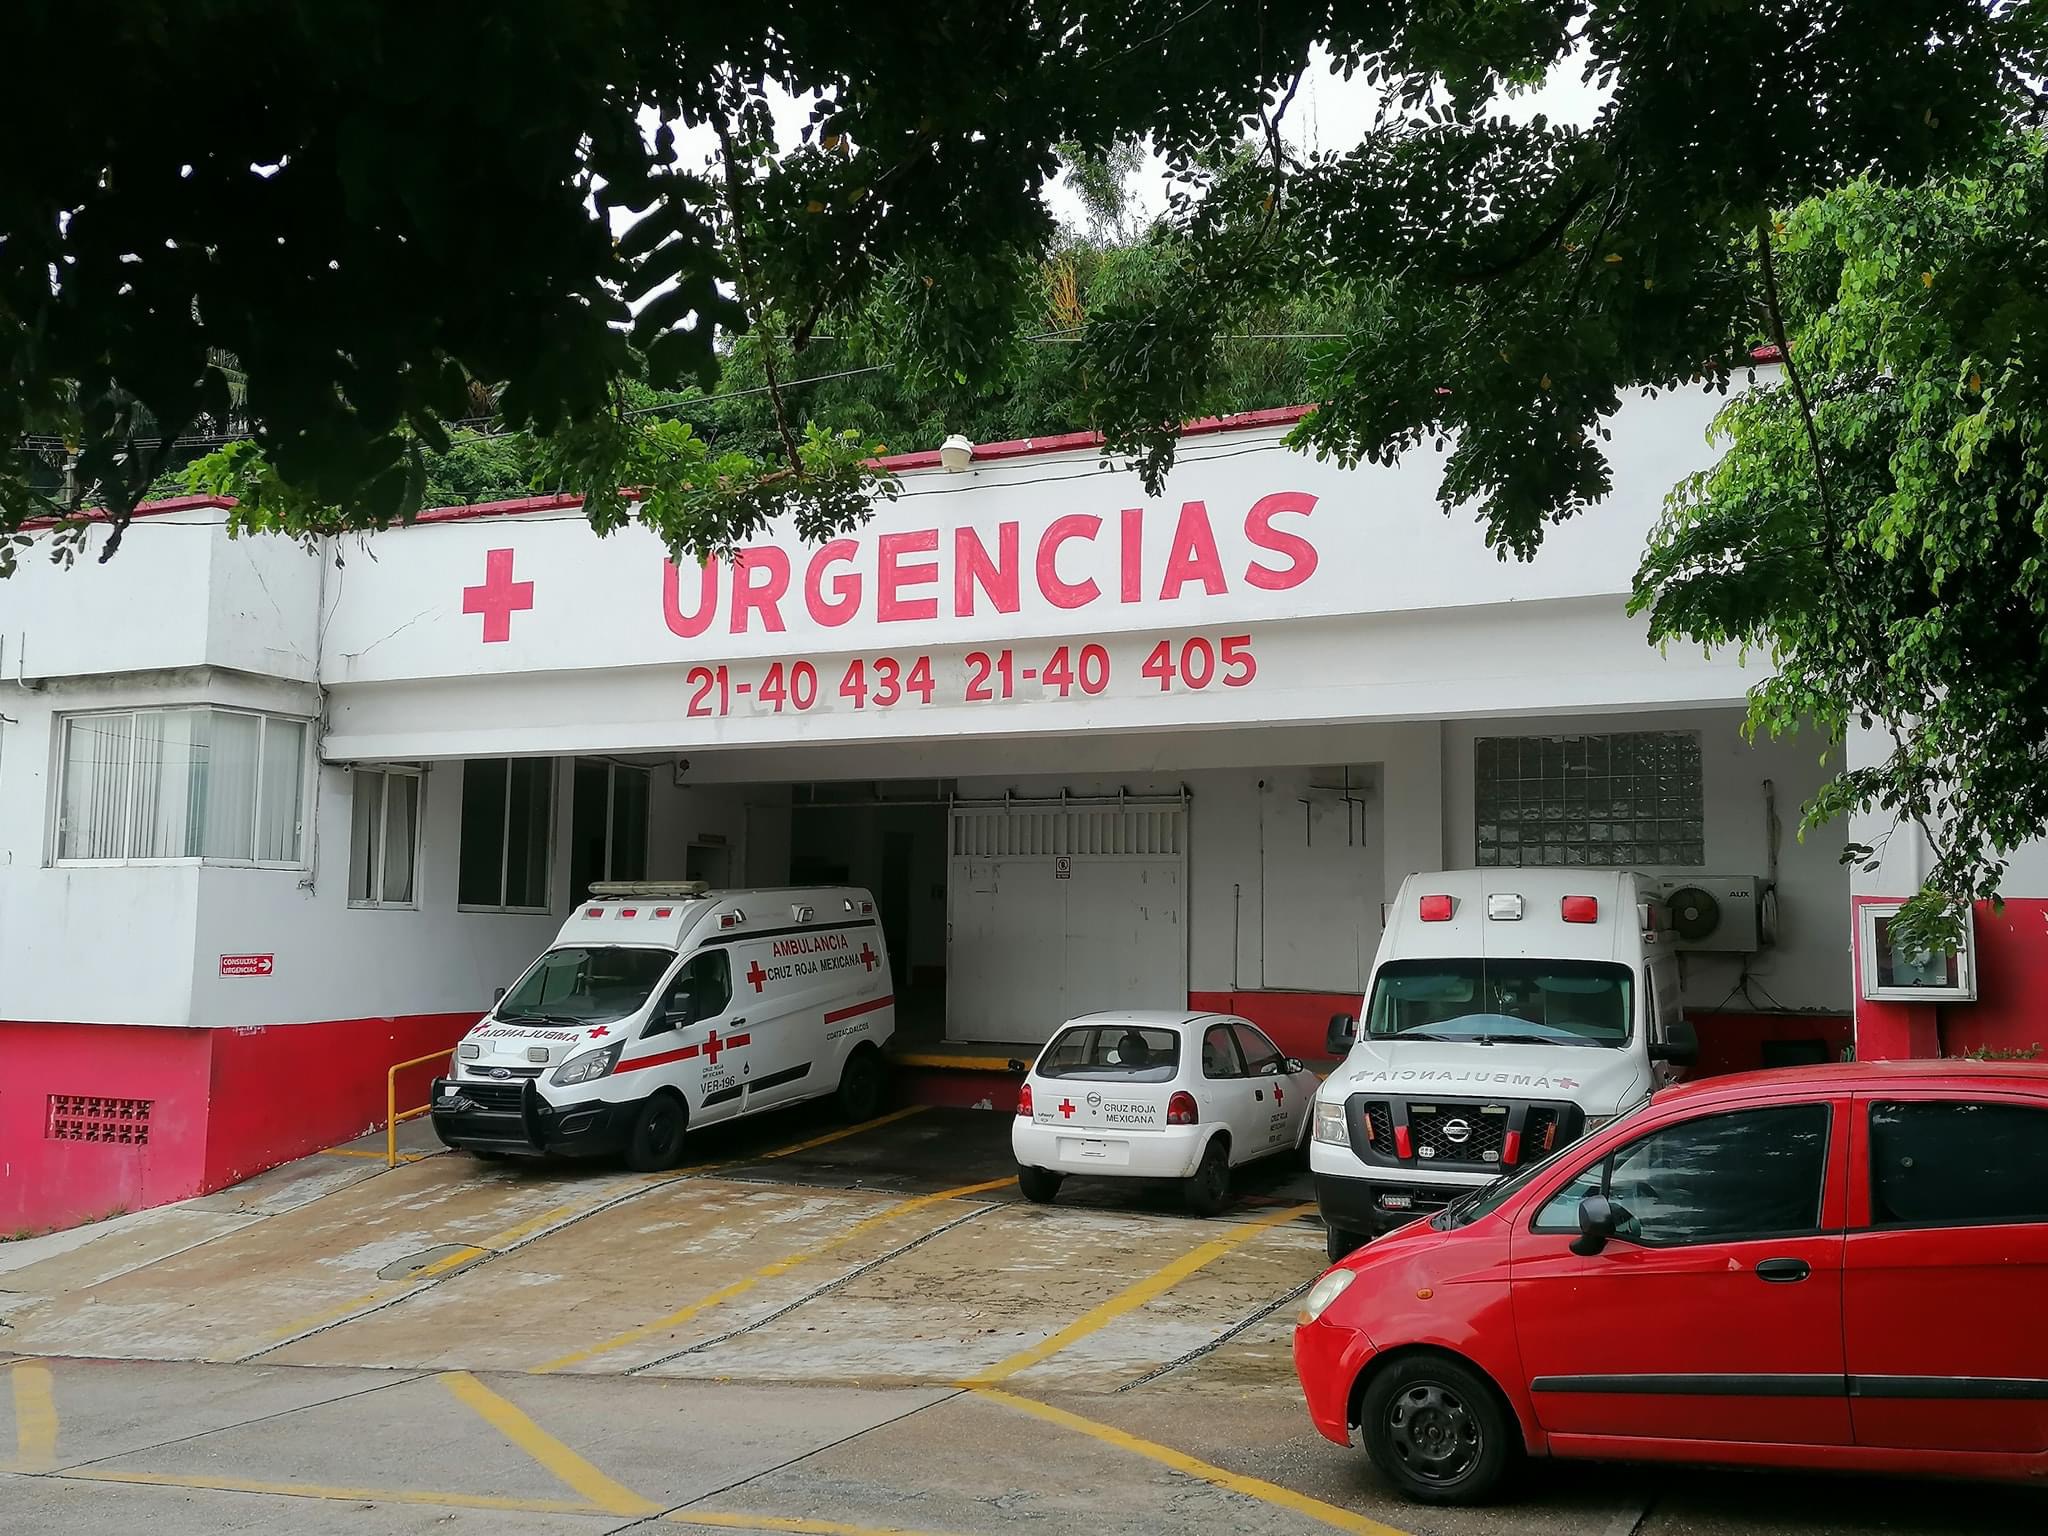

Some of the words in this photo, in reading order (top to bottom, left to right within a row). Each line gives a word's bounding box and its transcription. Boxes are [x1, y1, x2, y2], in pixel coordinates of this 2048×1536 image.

[663, 491, 1319, 638] URGENCIAS
[686, 660, 818, 718] 21-40
[839, 655, 936, 710] 434
[964, 643, 1110, 701] 21-40
[1141, 634, 1257, 692] 405
[773, 934, 849, 957] AMBULANCIA
[767, 965, 792, 980] CRUZ
[795, 960, 818, 976] ROJA
[820, 952, 861, 971] MEXICANA
[701, 1075, 735, 1094] VER-196
[1103, 1104, 1128, 1113] CRUZ
[1130, 1105, 1156, 1113] ROJA
[1105, 1114, 1154, 1124] MEXICANA
